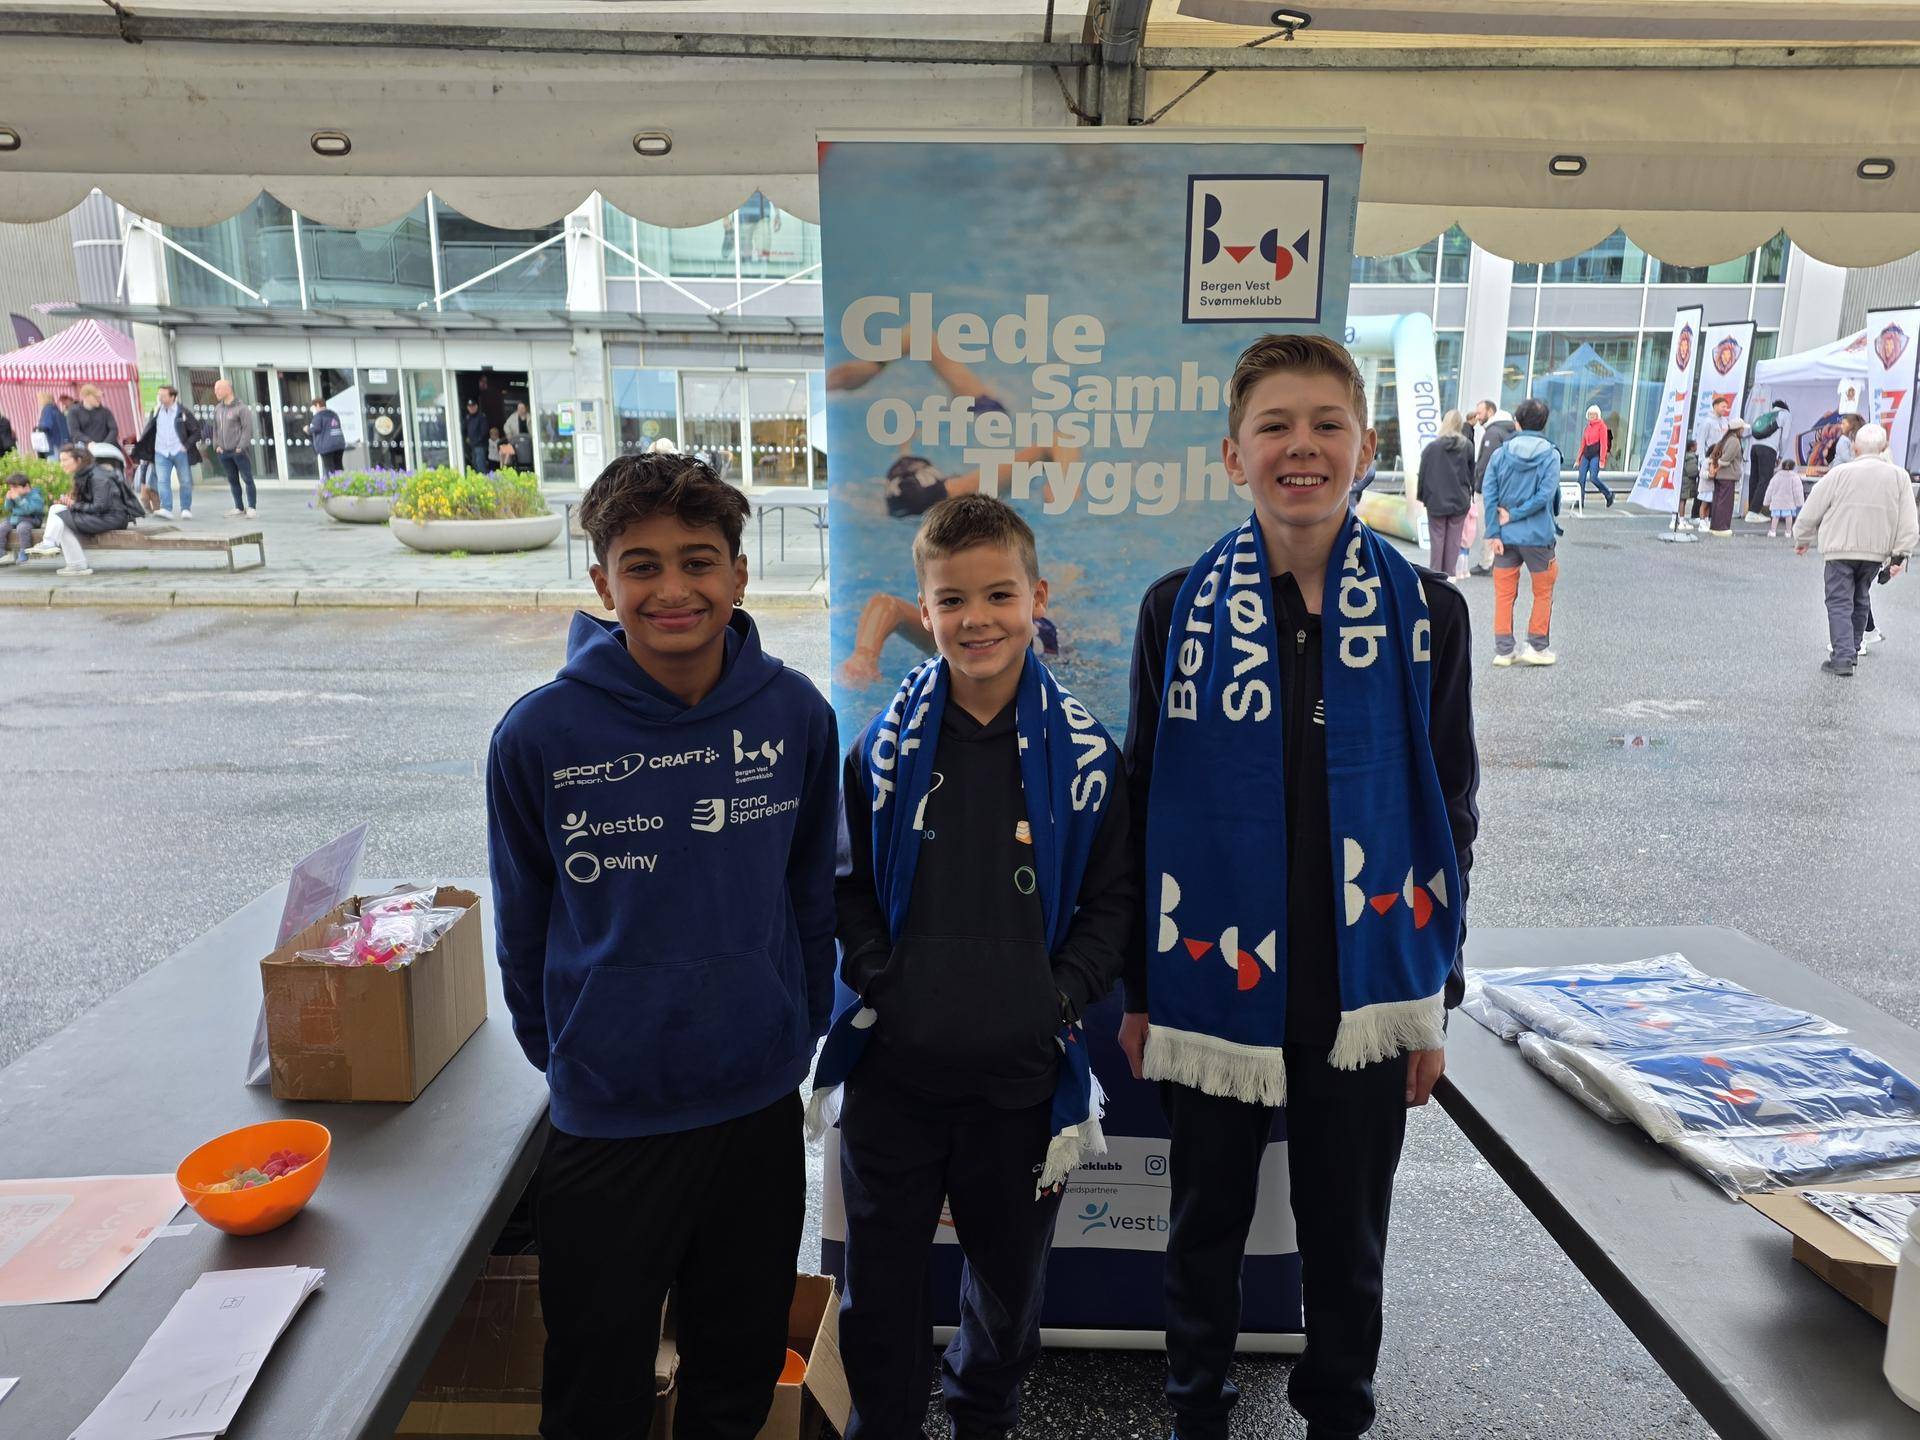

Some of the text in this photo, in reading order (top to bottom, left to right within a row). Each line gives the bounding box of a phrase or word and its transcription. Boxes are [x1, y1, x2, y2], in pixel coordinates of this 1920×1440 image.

[1200, 281, 1270, 293] Bergen Vest
[1200, 296, 1282, 306] Svømmeklubb
[841, 292, 1106, 364] Glede
[866, 395, 1155, 448] Offensiv
[963, 446, 1254, 516] Tryggh
[649, 750, 705, 769] CRAFT
[735, 768, 756, 777] Bergen
[731, 795, 768, 811] Fana
[590, 814, 664, 836] vestbo
[603, 852, 658, 873] eviny
[1078, 1162, 1123, 1171] eklubb
[1064, 1185, 1119, 1195] beidspartnere
[1109, 1214, 1169, 1232] vestb
